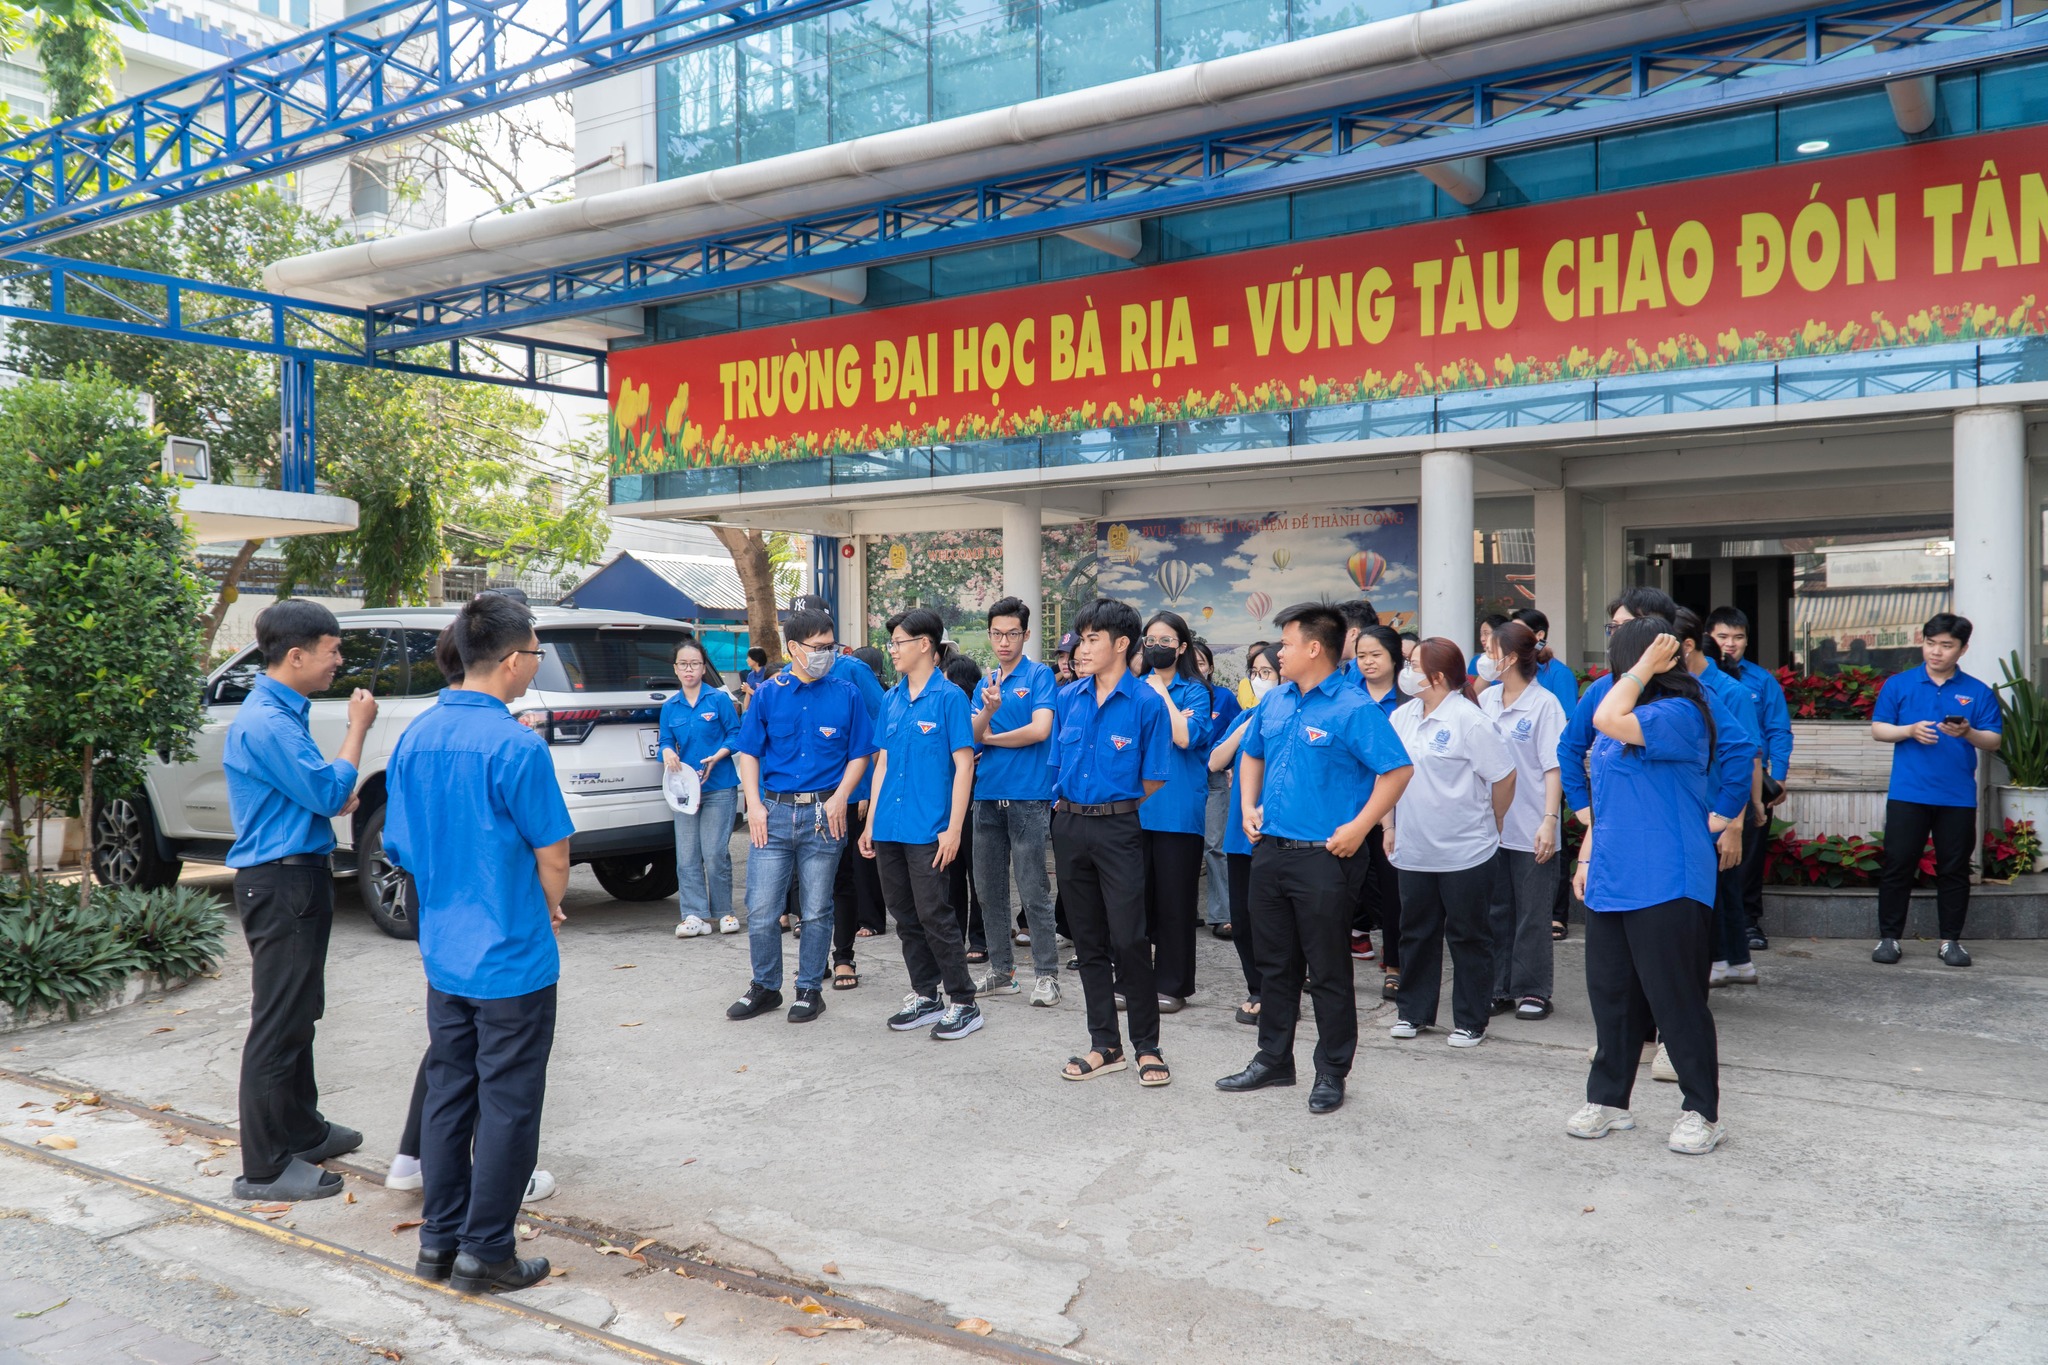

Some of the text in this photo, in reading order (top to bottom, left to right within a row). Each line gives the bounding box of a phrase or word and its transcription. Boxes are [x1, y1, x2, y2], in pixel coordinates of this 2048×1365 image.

[719, 338, 862, 420] TRƯỜNG
[872, 332, 939, 416] ĐẠI
[954, 318, 1036, 406] HỌC
[1051, 295, 1106, 381] BÀ
[1121, 297, 1197, 388] RỊA
[1245, 263, 1396, 357] VŨNG
[1414, 239, 1520, 337] TÀU
[1543, 211, 1714, 322] CHÀO
[1736, 182, 1896, 298] ĐÓN
[1141, 525, 1167, 538] BVU
[1237, 516, 1288, 533] NGHIỆM
[1292, 513, 1309, 529] ĐỂ
[1312, 511, 1361, 528] THÀNH
[1363, 510, 1404, 526] CÔNG
[927, 547, 985, 561] WELCOME
[569, 777, 625, 785] TITANIUM
